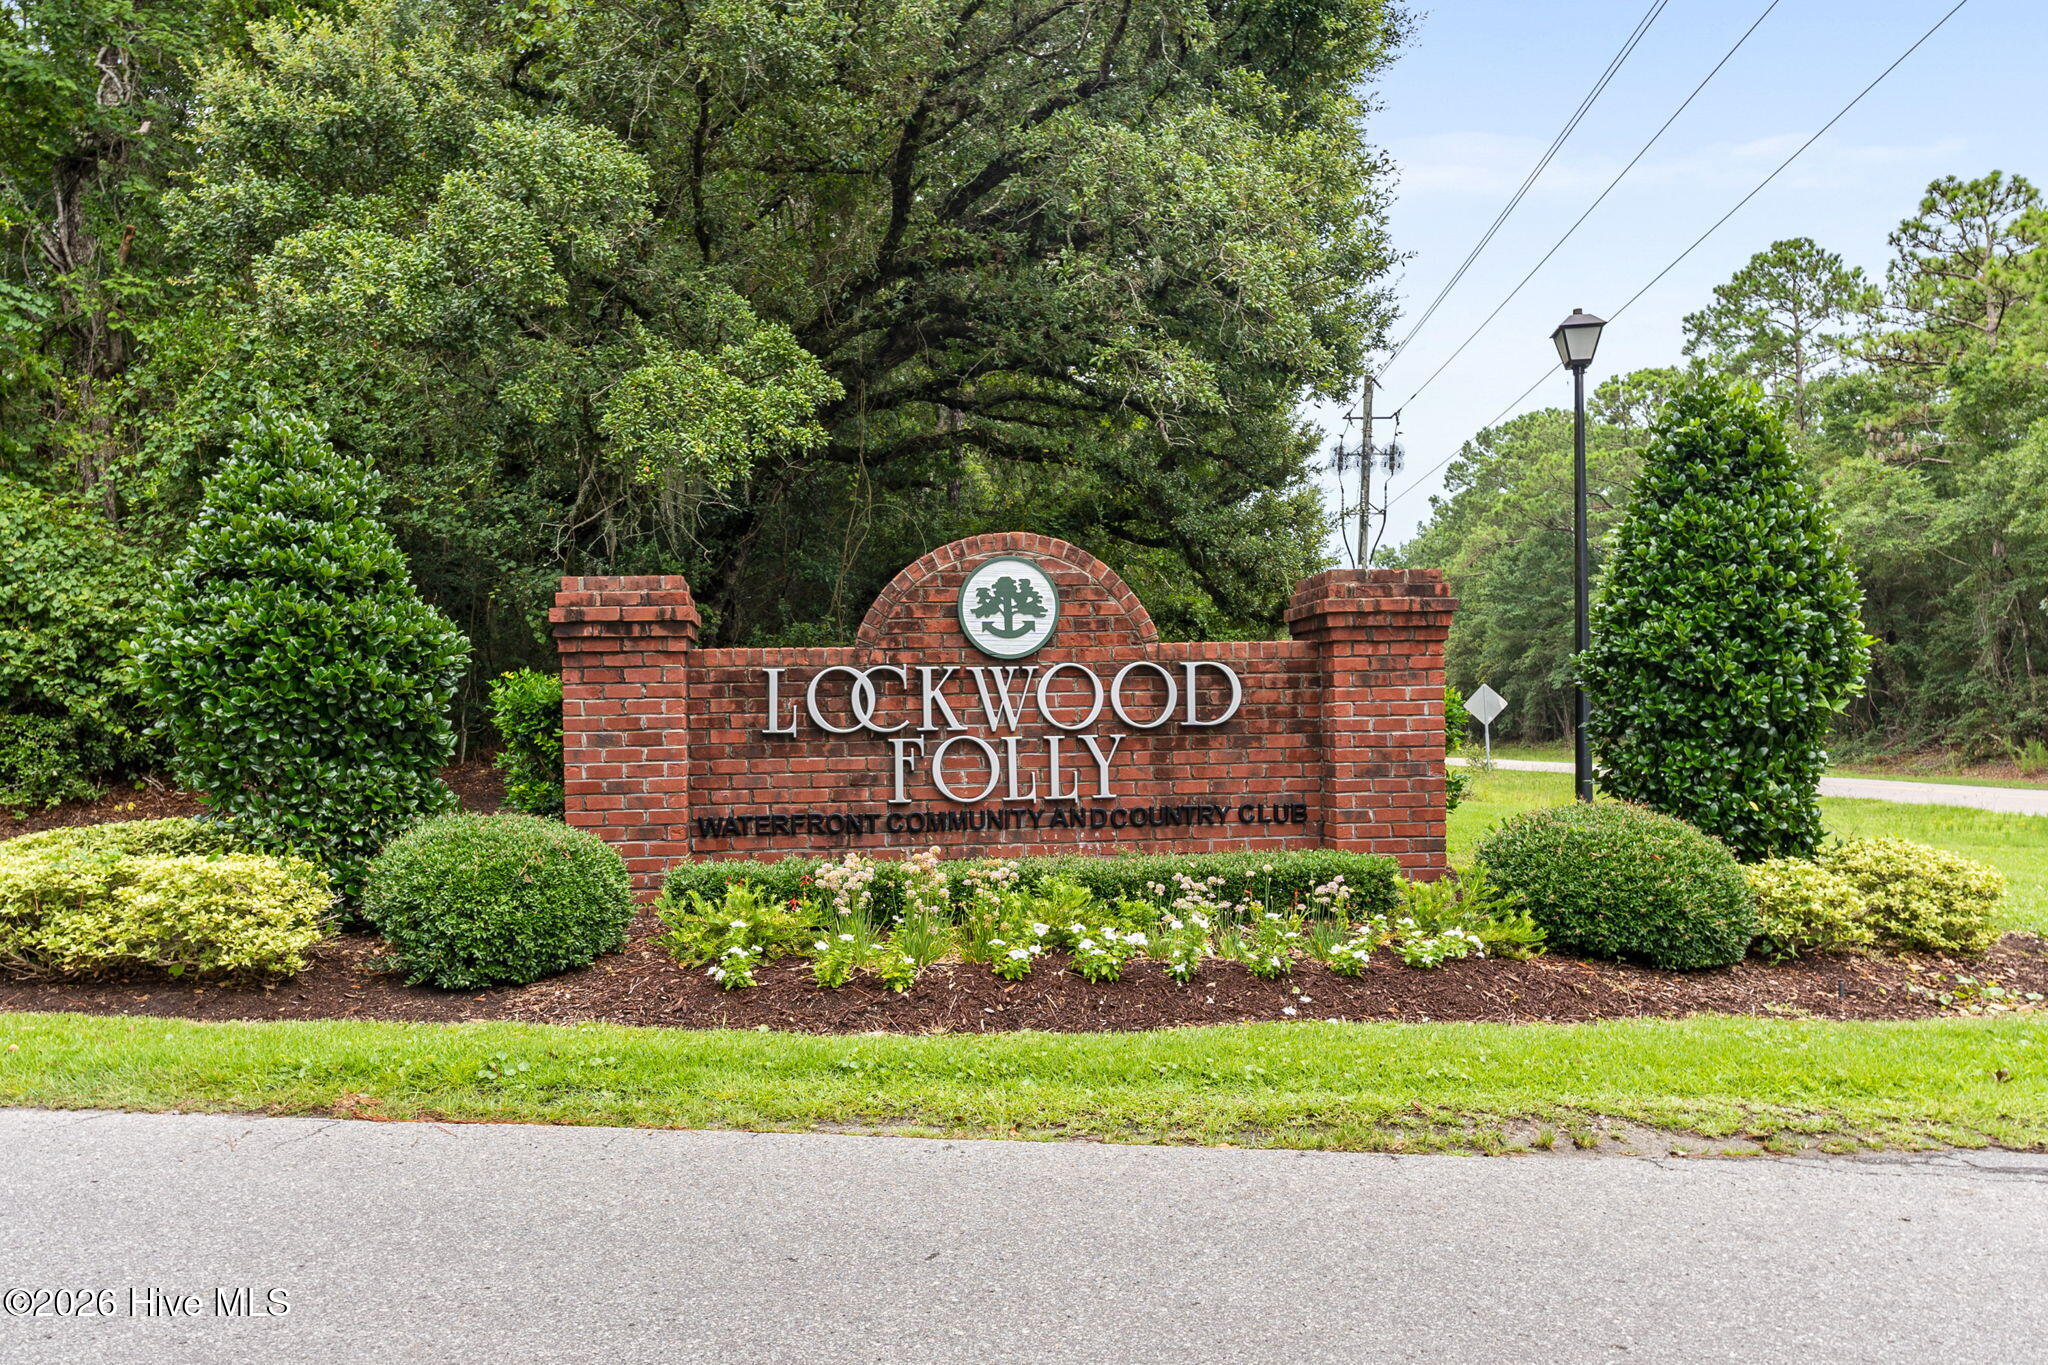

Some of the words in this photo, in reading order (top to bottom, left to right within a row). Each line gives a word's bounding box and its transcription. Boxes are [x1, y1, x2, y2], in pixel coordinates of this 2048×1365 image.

[762, 661, 1243, 738] LOCKWOOD
[887, 733, 1126, 804] FOLLY
[698, 812, 881, 838] WATERFRONT
[886, 808, 1043, 834] COMMUNITY
[1049, 805, 1107, 829] AND
[1109, 803, 1231, 829] COUNTRY
[1237, 802, 1308, 825] CLUB
